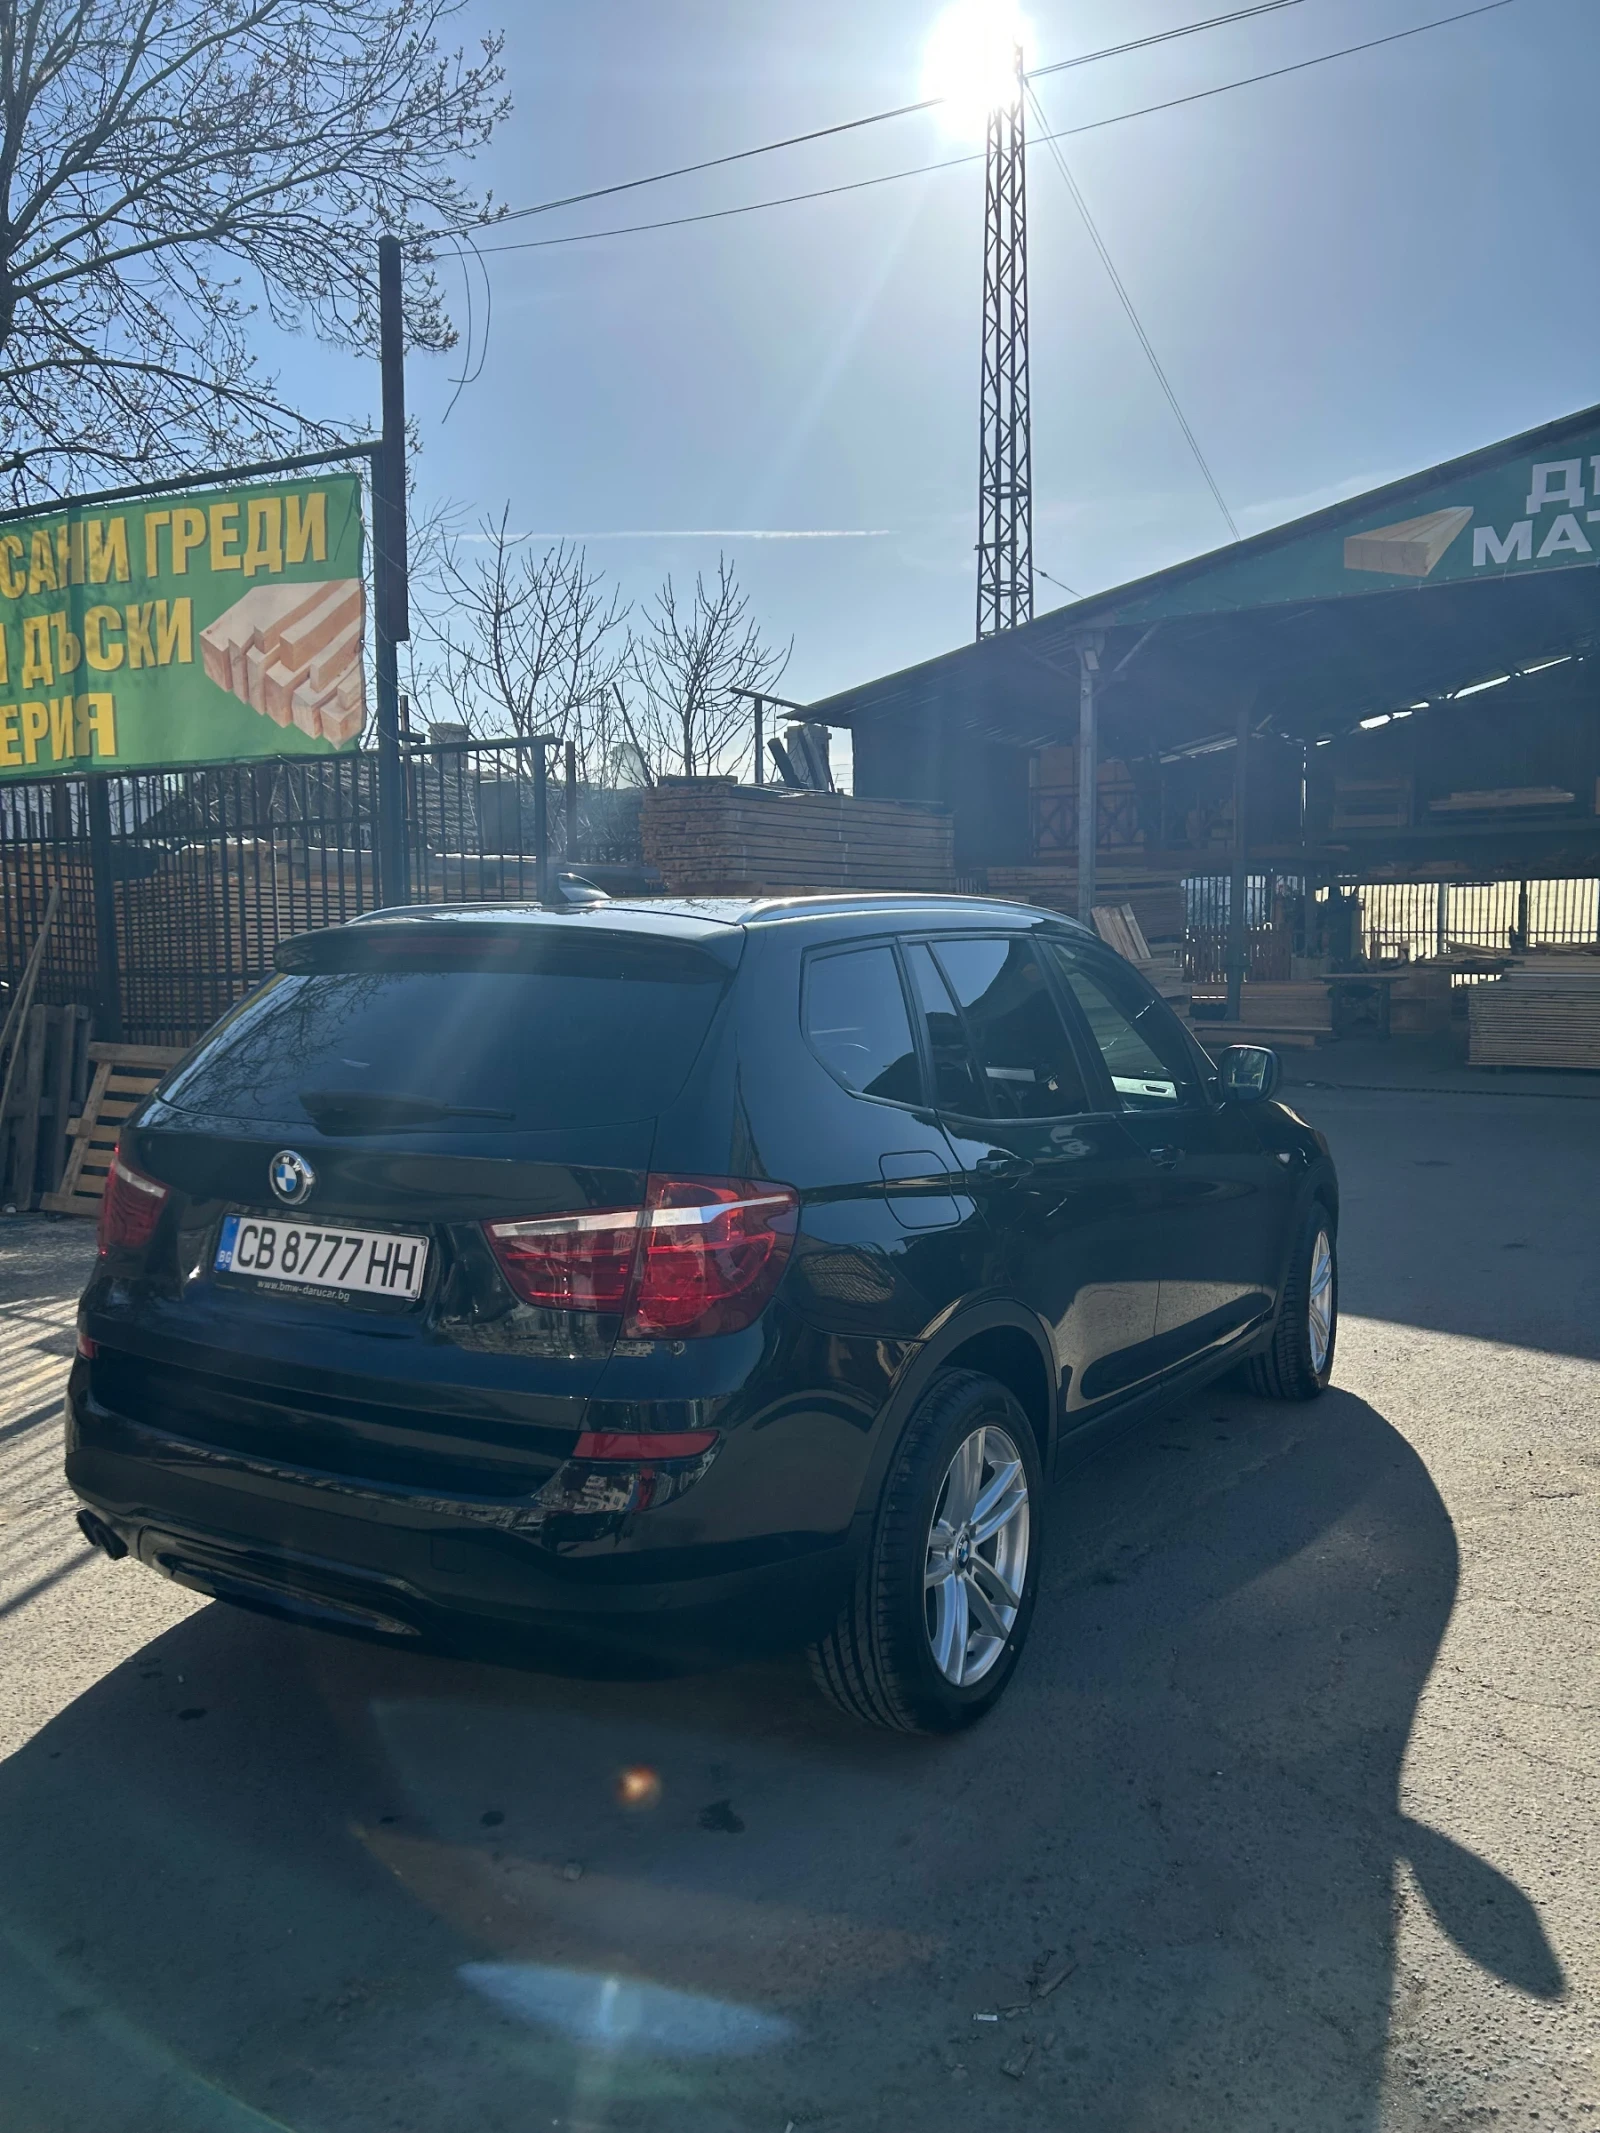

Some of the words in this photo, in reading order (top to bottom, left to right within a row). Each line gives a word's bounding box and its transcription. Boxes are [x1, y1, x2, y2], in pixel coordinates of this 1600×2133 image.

[0, 517, 131, 599] САНИ
[145, 492, 328, 578] ГРЕДИ
[22, 597, 193, 689] ДЪСКИ
[0, 692, 117, 767] ЕРИЯ
[218, 1250, 232, 1264] BG
[281, 1230, 364, 1281] 8777
[365, 1241, 417, 1290] HH
[257, 1280, 350, 1302] www.bmw-darucar.bg
